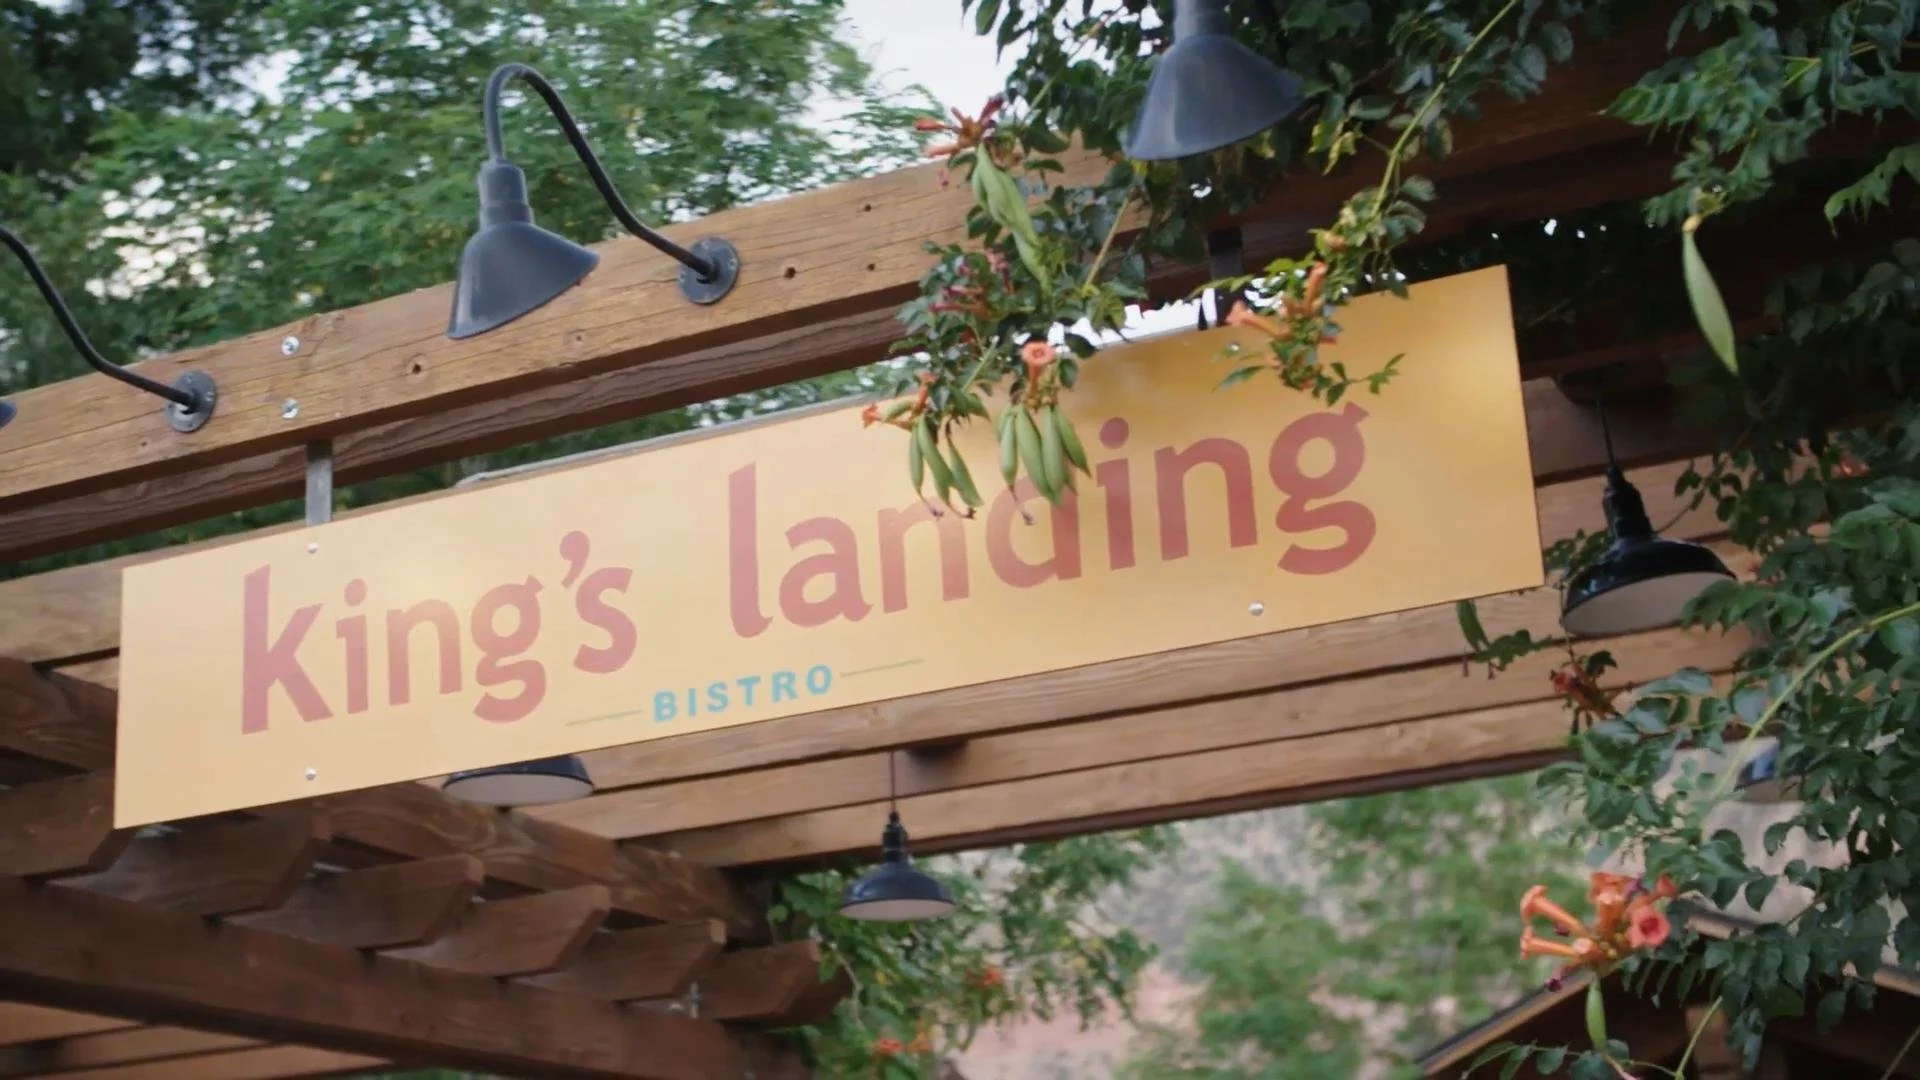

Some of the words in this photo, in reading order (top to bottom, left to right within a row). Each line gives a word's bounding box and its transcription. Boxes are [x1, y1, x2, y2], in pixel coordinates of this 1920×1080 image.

[241, 530, 638, 735] king's
[728, 401, 1377, 639] landing
[653, 664, 833, 723] BISTRO
